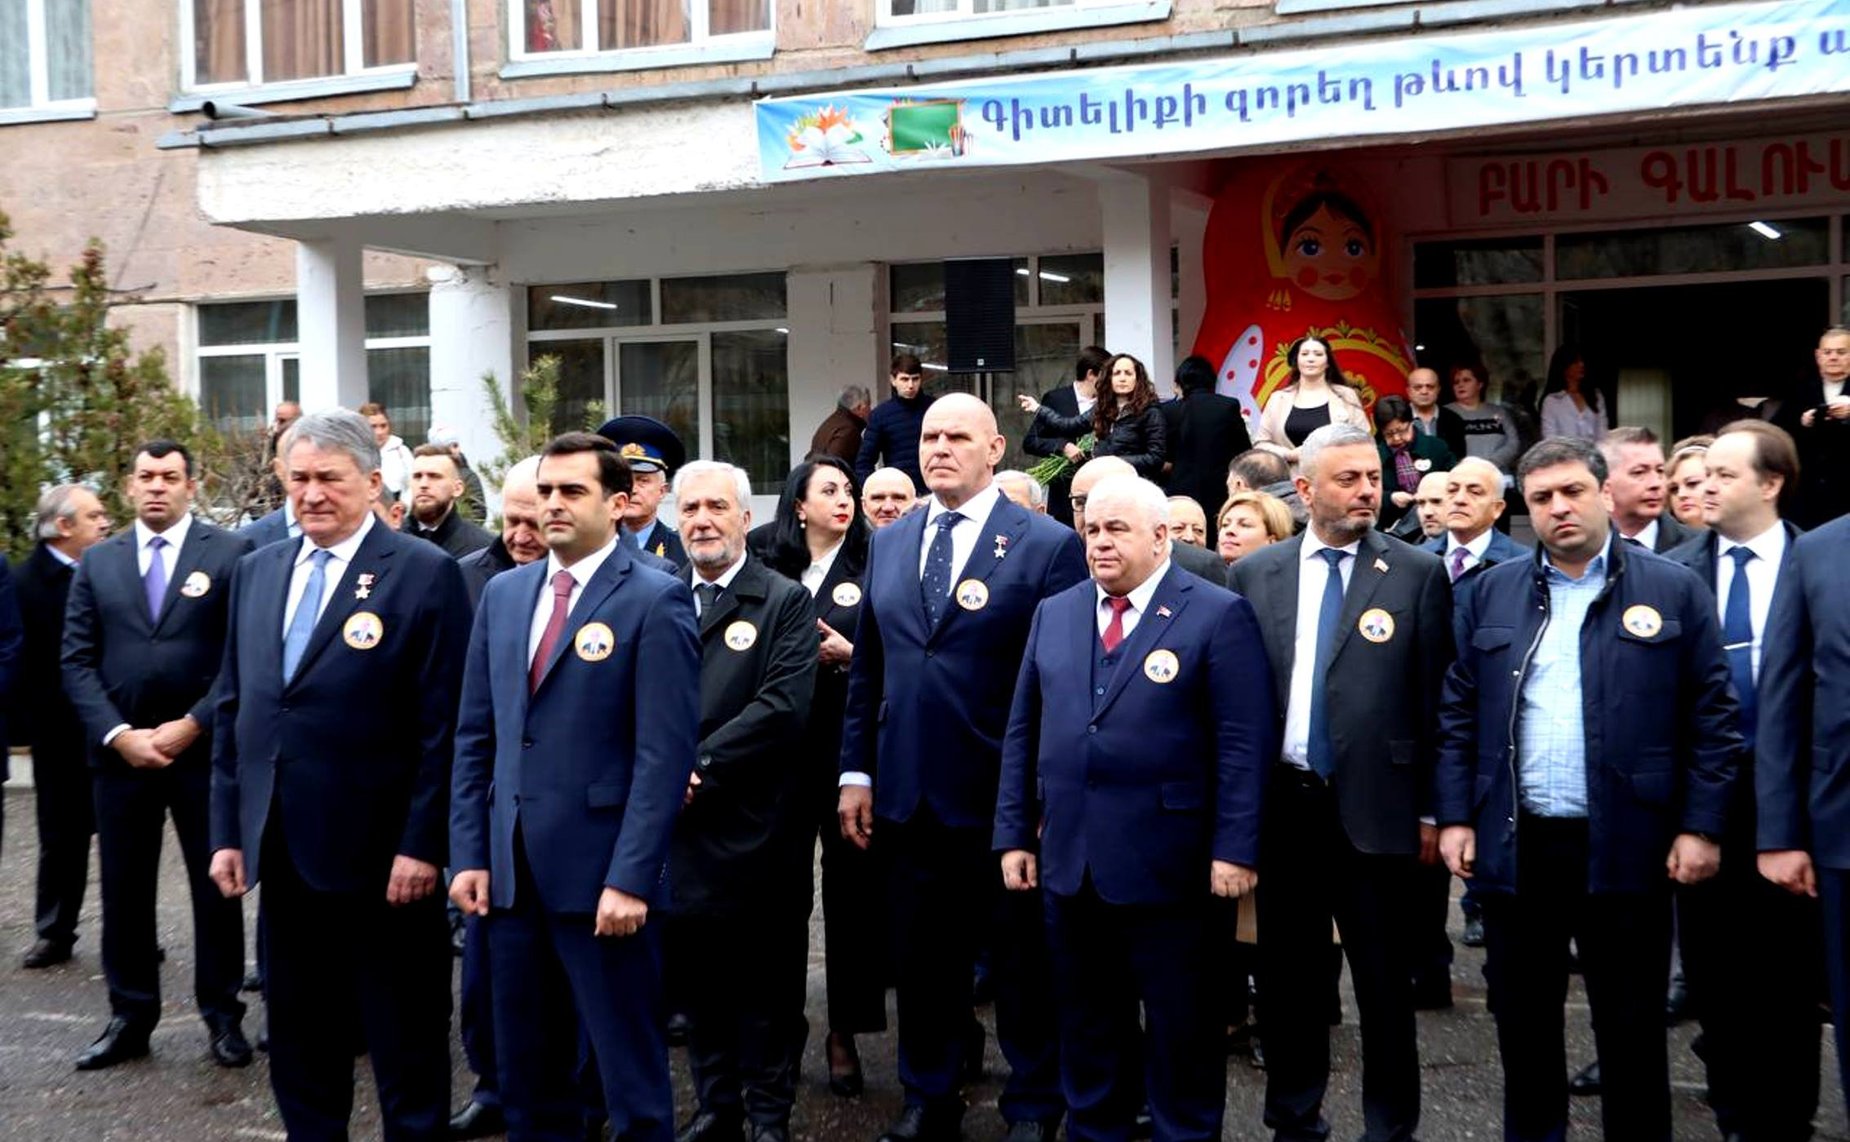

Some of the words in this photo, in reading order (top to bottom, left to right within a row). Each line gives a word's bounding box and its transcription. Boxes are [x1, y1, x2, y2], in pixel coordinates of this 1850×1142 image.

[982, 84, 1206, 140] Գիտելիքի
[1225, 70, 1376, 121] զորեղ
[1395, 52, 1527, 108] թևով
[1546, 30, 1797, 93] կերտենք
[1478, 157, 1609, 216] ԲԱՐԻ
